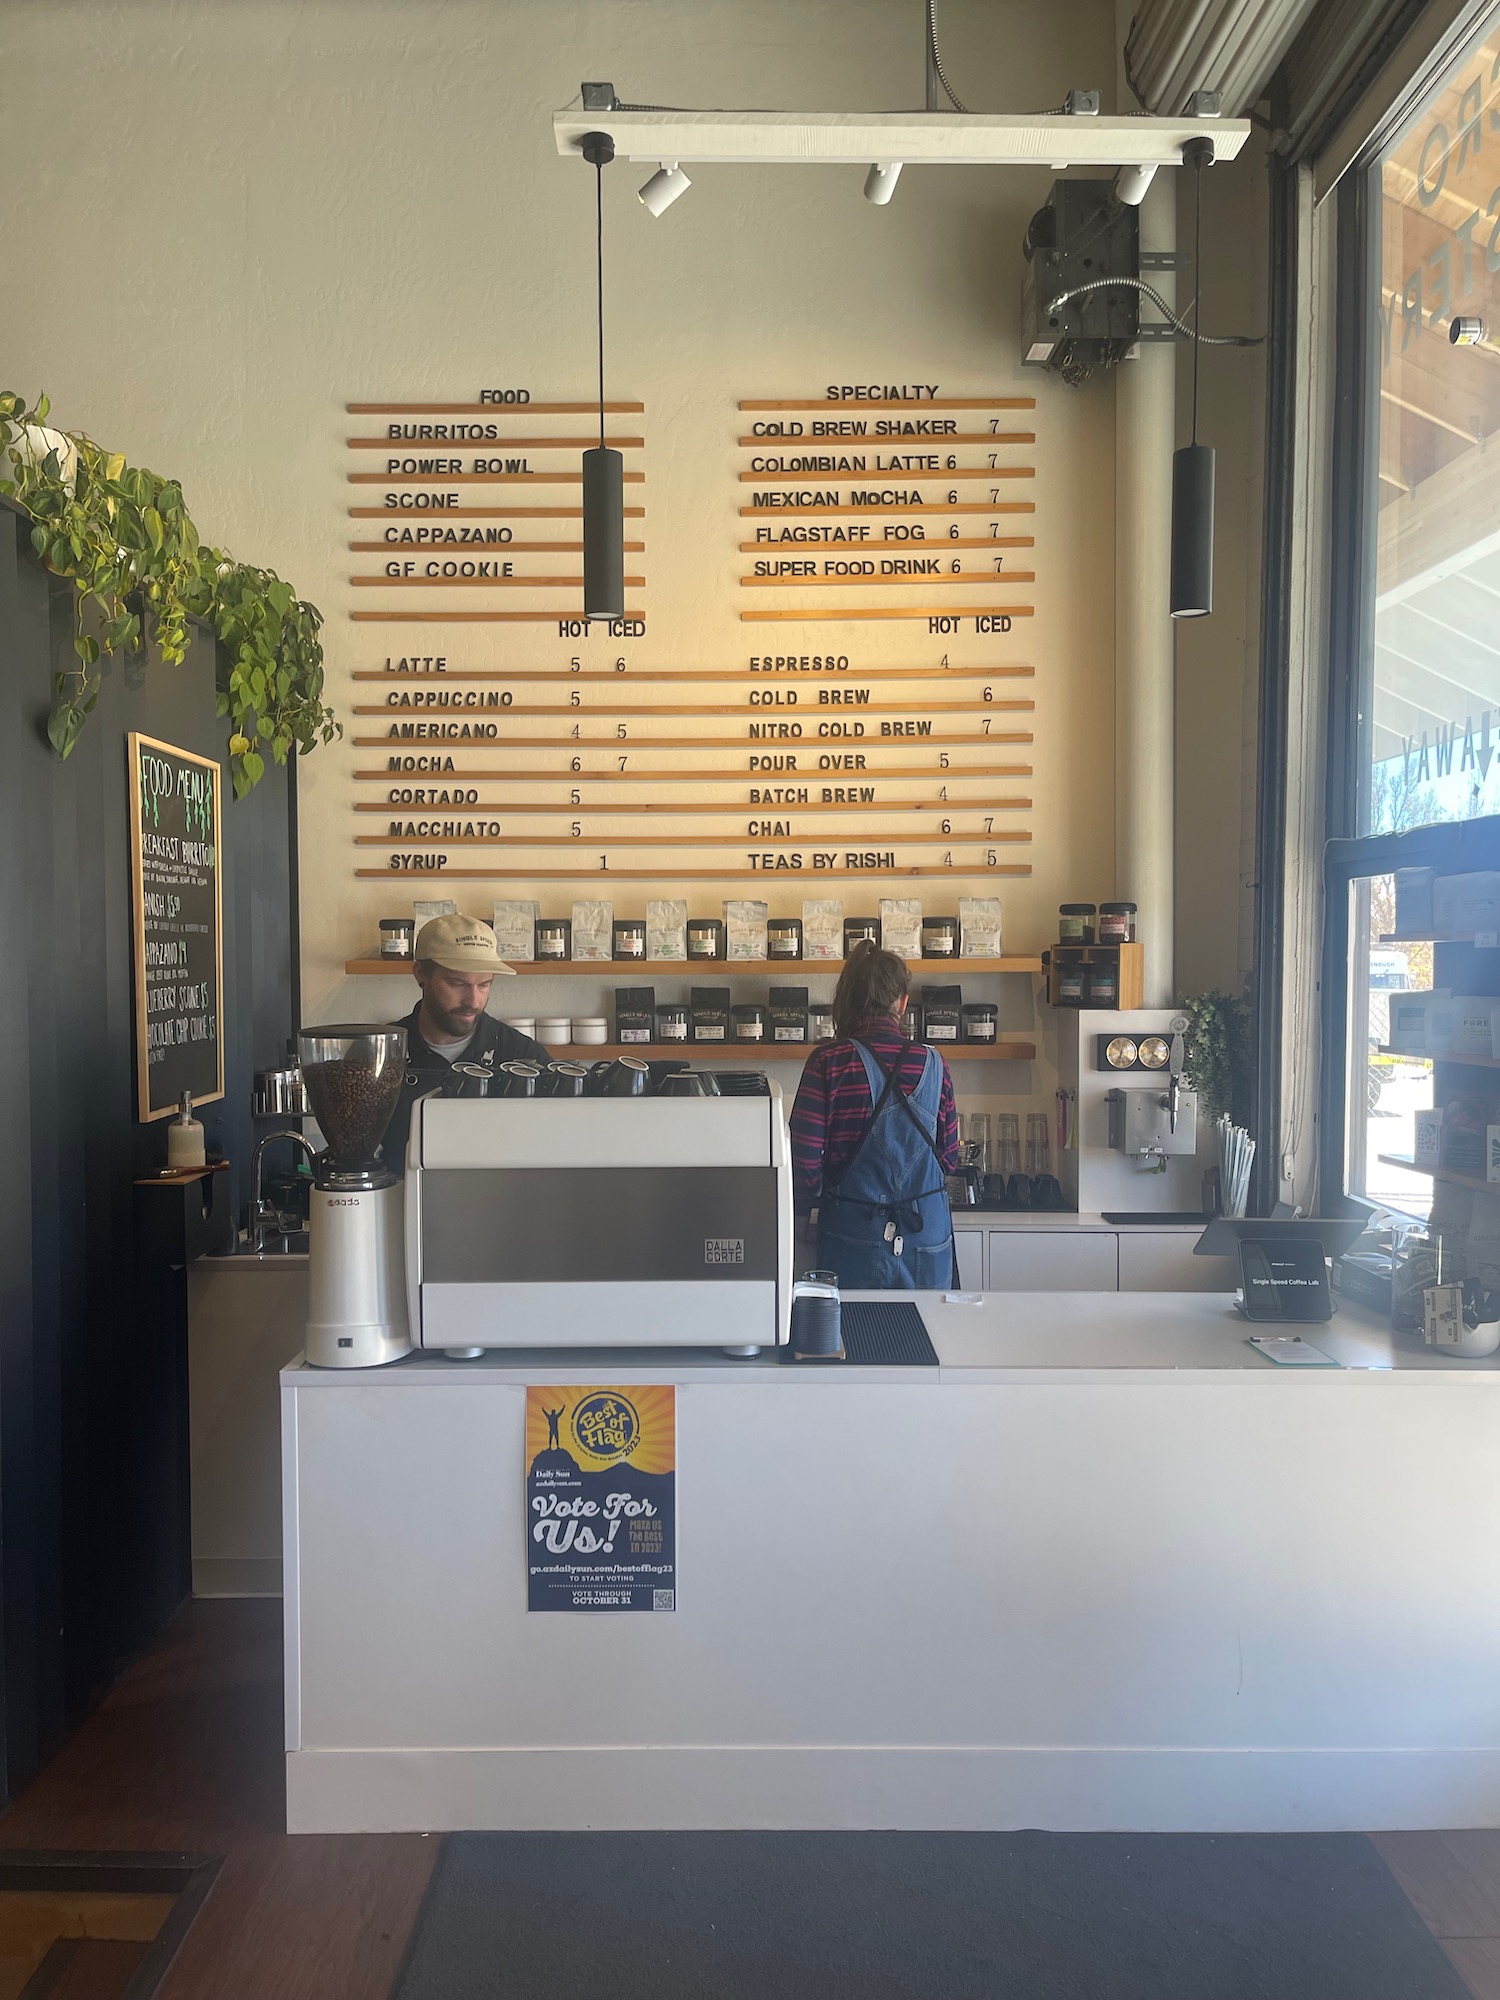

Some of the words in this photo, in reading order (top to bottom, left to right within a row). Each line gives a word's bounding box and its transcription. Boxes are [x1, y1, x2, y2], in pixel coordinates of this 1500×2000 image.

[481, 390, 529, 404] FOOD
[827, 386, 938, 400] SPECIALTY
[389, 425, 497, 440] BURRITOS
[753, 422, 803, 436] COLD
[813, 422, 867, 436] BREW
[876, 420, 957, 435] SHAKER
[990, 420, 999, 434] 7
[388, 459, 462, 474] POWER
[474, 459, 533, 474] BOWL
[752, 457, 865, 472] COLOMBIAN
[877, 456, 939, 470] LATTE
[947, 455, 956, 469] 6
[989, 454, 997, 468] 7
[385, 493, 458, 508] SCONE
[753, 492, 838, 507] MEXICAN
[851, 491, 923, 505] MOCHA
[948, 490, 957, 504] 6
[991, 489, 999, 503] 7
[385, 528, 512, 543] CAPPAZANO
[757, 527, 870, 542] FLAGSTAFF
[884, 525, 924, 540] FOG
[950, 525, 958, 539] 6
[990, 523, 998, 538] 7
[386, 562, 415, 577] GF
[426, 562, 512, 577] COOKIE
[755, 562, 816, 576] SUPER
[825, 561, 874, 575] FOOD
[881, 559, 940, 574] DRINK
[952, 559, 960, 573] 6
[995, 558, 1002, 572] 7
[559, 621, 591, 637] HOT
[609, 621, 645, 637] ICED
[929, 616, 960, 633] HOT
[976, 615, 1011, 633] ICED
[387, 658, 446, 672] LATTE
[570, 658, 580, 672] 5
[616, 658, 625, 672] 6
[750, 656, 848, 671] ESPRESSO
[941, 655, 949, 669] 4
[387, 692, 512, 707] CAPPUCCINO
[572, 692, 580, 706] 5
[750, 691, 797, 705] COLD
[819, 690, 869, 704] BREW
[984, 687, 992, 701] 6
[387, 724, 497, 739] AMERICANO
[572, 724, 580, 739] 4
[618, 724, 626, 738] 5
[750, 723, 802, 738] NITRO
[819, 723, 864, 737] COLD
[881, 721, 931, 736] BREW
[983, 720, 991, 734] 7
[389, 757, 454, 771] MOCHA
[572, 757, 580, 771] 6
[619, 757, 627, 771] 7
[750, 756, 796, 770] POUR
[819, 755, 866, 769] OVER
[941, 753, 948, 768] 5
[142, 755, 173, 797] FOOD
[177, 769, 204, 804] MENU
[389, 789, 478, 804] CORTADO
[572, 790, 580, 805] 5
[750, 789, 807, 803] BATCH
[823, 788, 874, 802] BREW
[940, 787, 946, 801] 4
[389, 822, 500, 838] MACCHIATO
[572, 822, 580, 837] 5
[749, 821, 789, 836] CHAI
[942, 819, 950, 834] 6
[985, 818, 993, 833] 7
[389, 855, 447, 871] SYRUP
[600, 855, 608, 870] 1
[748, 854, 802, 869] TEAS
[813, 854, 837, 868] BY
[846, 853, 894, 868] RISHI
[945, 852, 952, 866] 4
[988, 850, 996, 866] 5
[145, 891, 165, 918] ANISH
[455, 935, 478, 943] SINGLE
[146, 941, 177, 966] APPAZANO
[147, 985, 177, 1013] LUEBERRY
[179, 985, 200, 1011] SCONE
[147, 1019, 176, 1049] HOCOLATE
[706, 1241, 742, 1251] DALLA
[706, 1251, 742, 1262] CORTE
[579, 1400, 618, 1430] Best
[609, 1412, 630, 1430] of
[581, 1422, 626, 1449] Flag
[622, 1435, 642, 1458] 2023
[536, 1470, 554, 1479] Daily
[555, 1470, 570, 1478] Sun
[532, 1493, 600, 1518] Vote
[602, 1493, 658, 1520] For
[533, 1519, 621, 1554] Us!
[641, 1542, 662, 1553] 2023!
[530, 1564, 673, 1575] go.azdailysun.com/bestofflag23
[572, 1597, 619, 1605] OCTOBER
